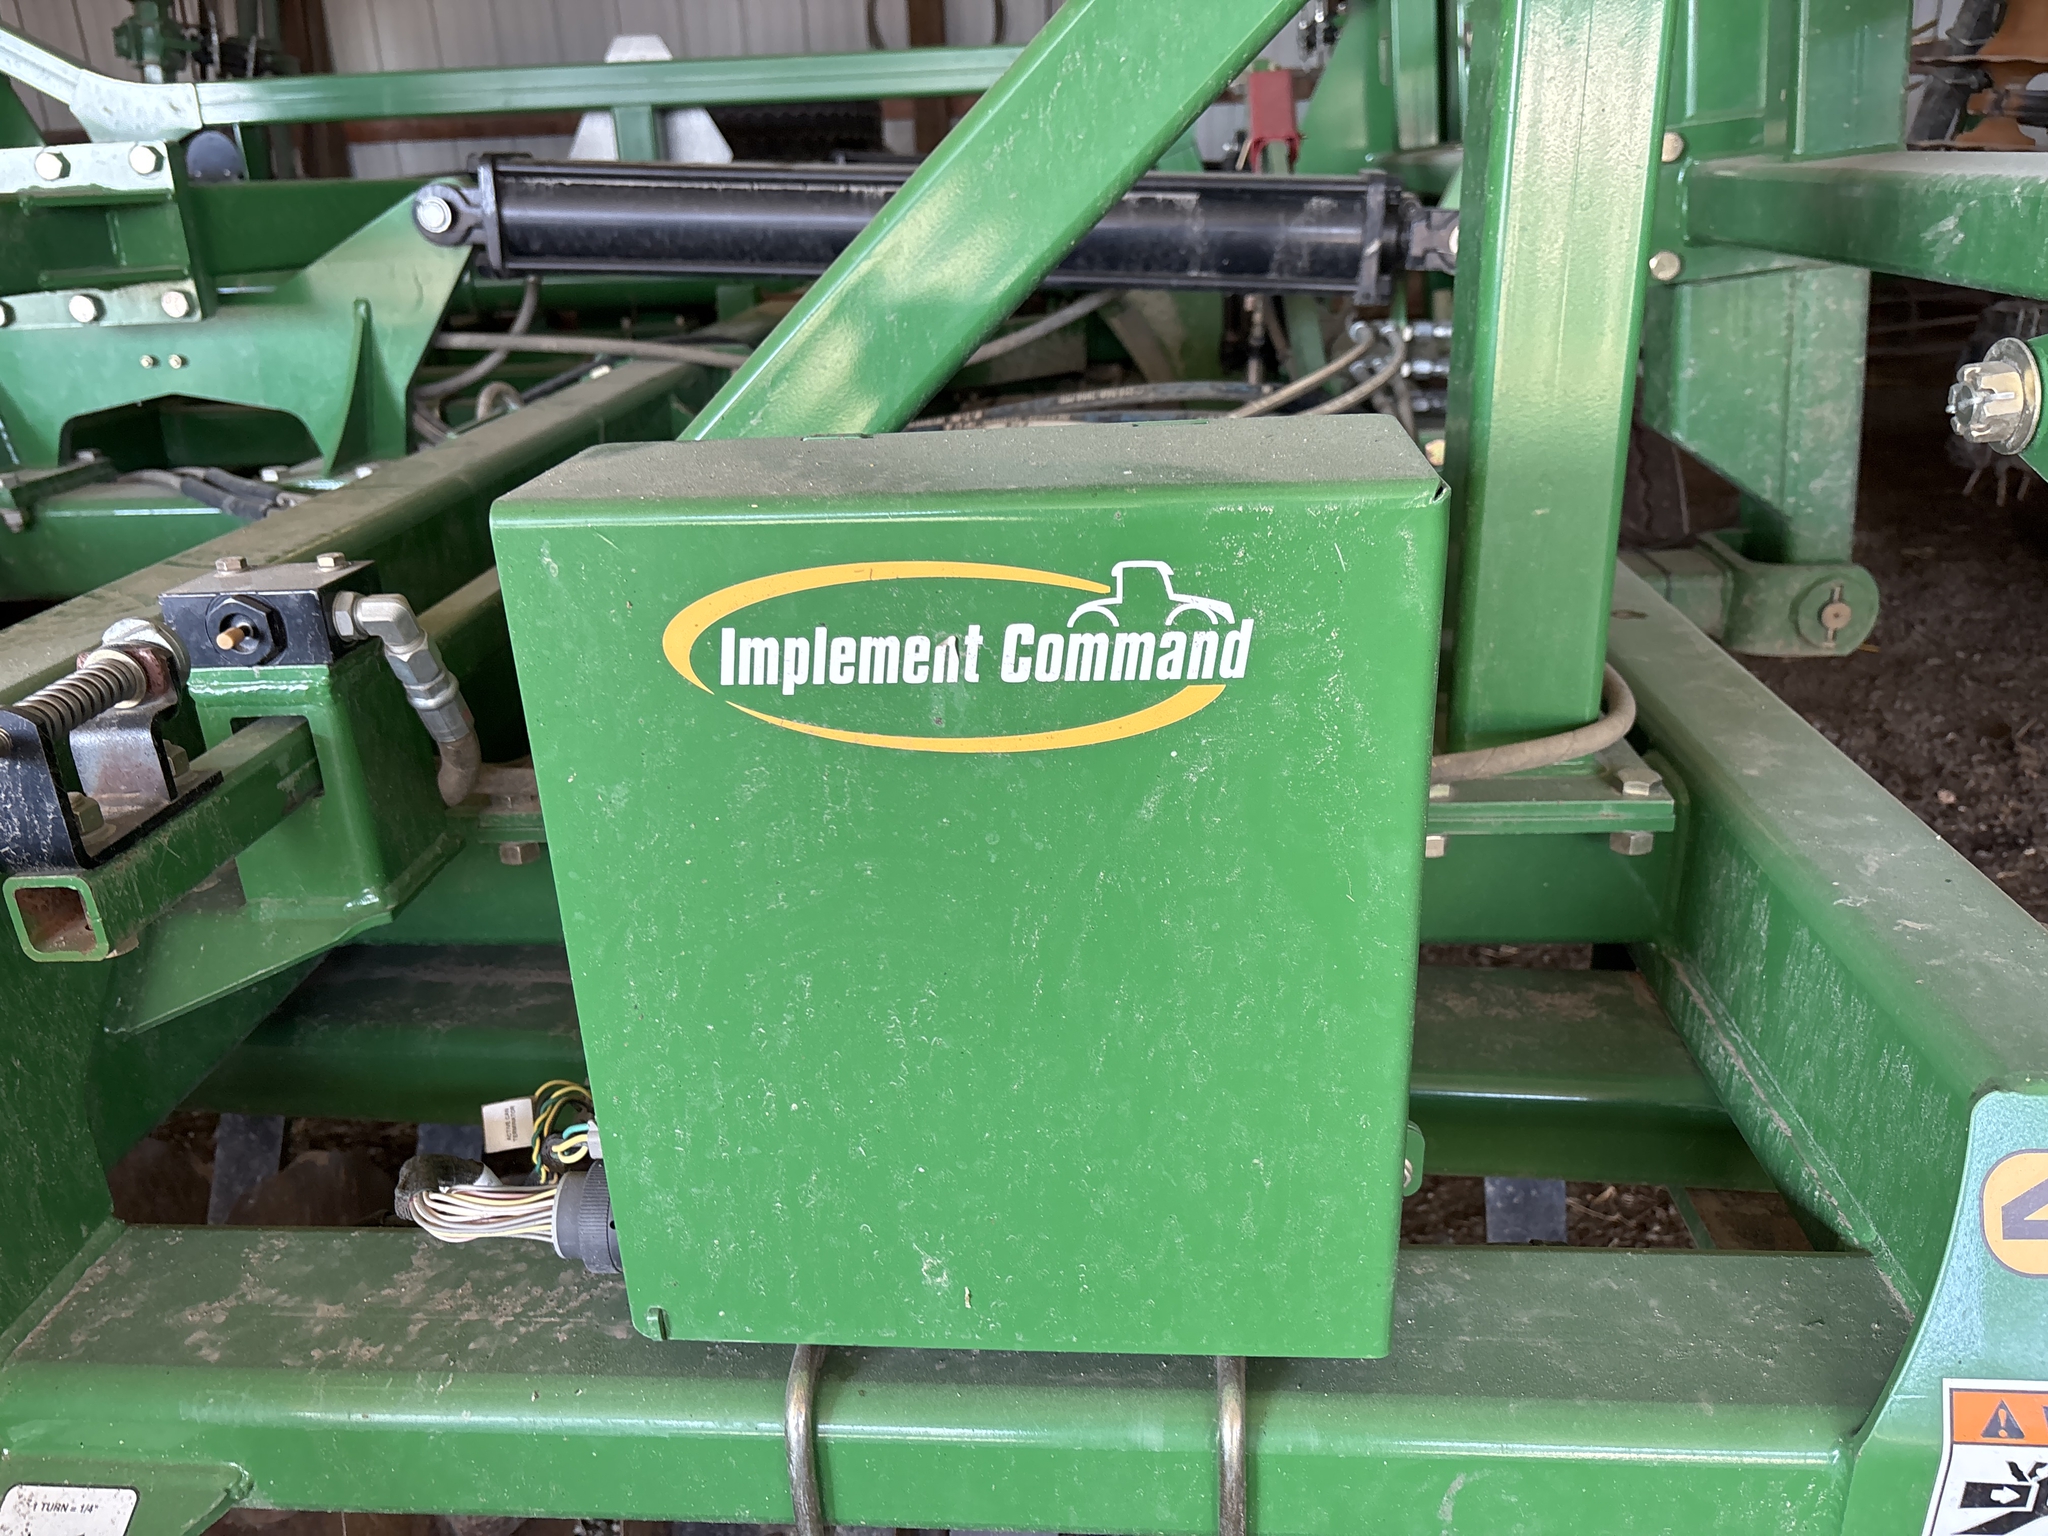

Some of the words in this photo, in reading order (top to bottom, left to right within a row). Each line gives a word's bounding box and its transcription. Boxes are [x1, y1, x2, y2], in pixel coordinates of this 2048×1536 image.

[720, 625, 983, 695] Implement
[1000, 619, 1254, 683] Command
[41, 1502, 69, 1513] TURN
[80, 1503, 99, 1514] 1/4"
